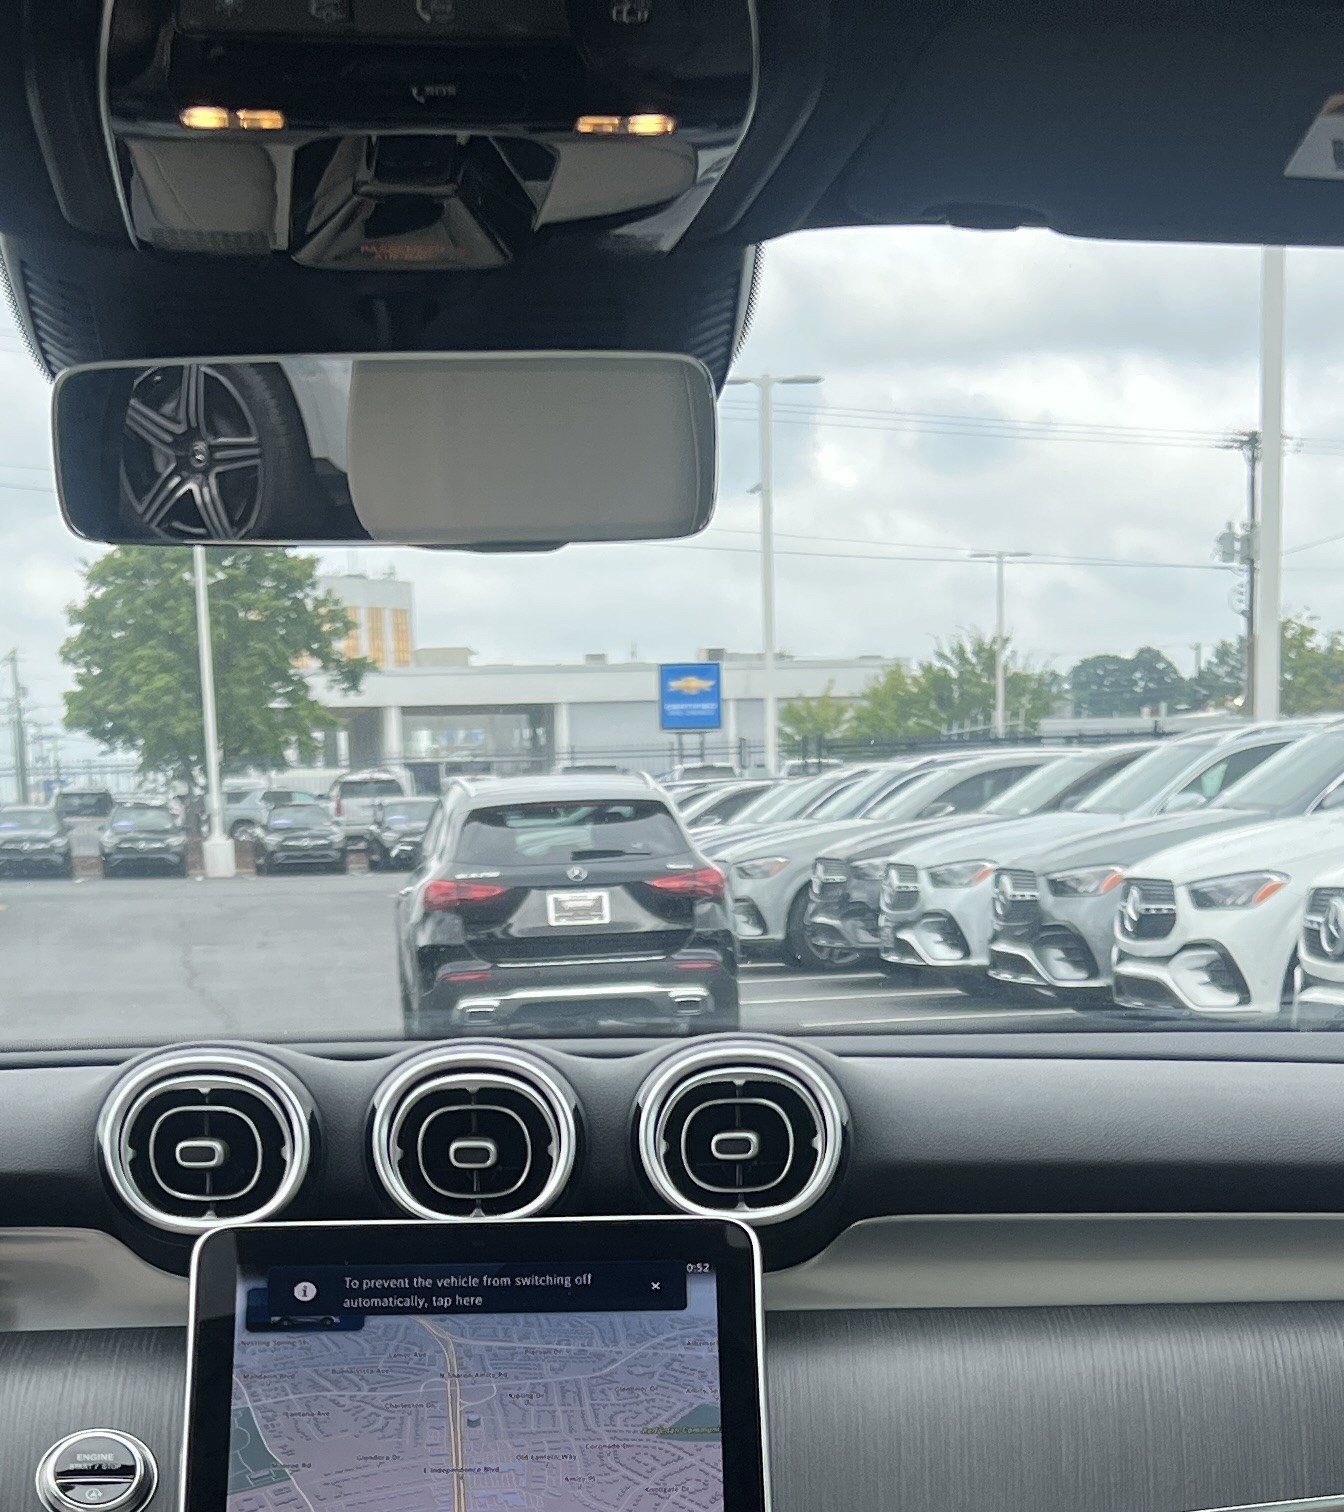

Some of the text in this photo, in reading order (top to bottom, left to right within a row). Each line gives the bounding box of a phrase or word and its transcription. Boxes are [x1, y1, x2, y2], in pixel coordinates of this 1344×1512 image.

[344, 1273, 592, 1291] To prevent the vehicle from switching off
[343, 1295, 483, 1309] automatically, tap here
[76, 1453, 115, 1462] ENGINE
